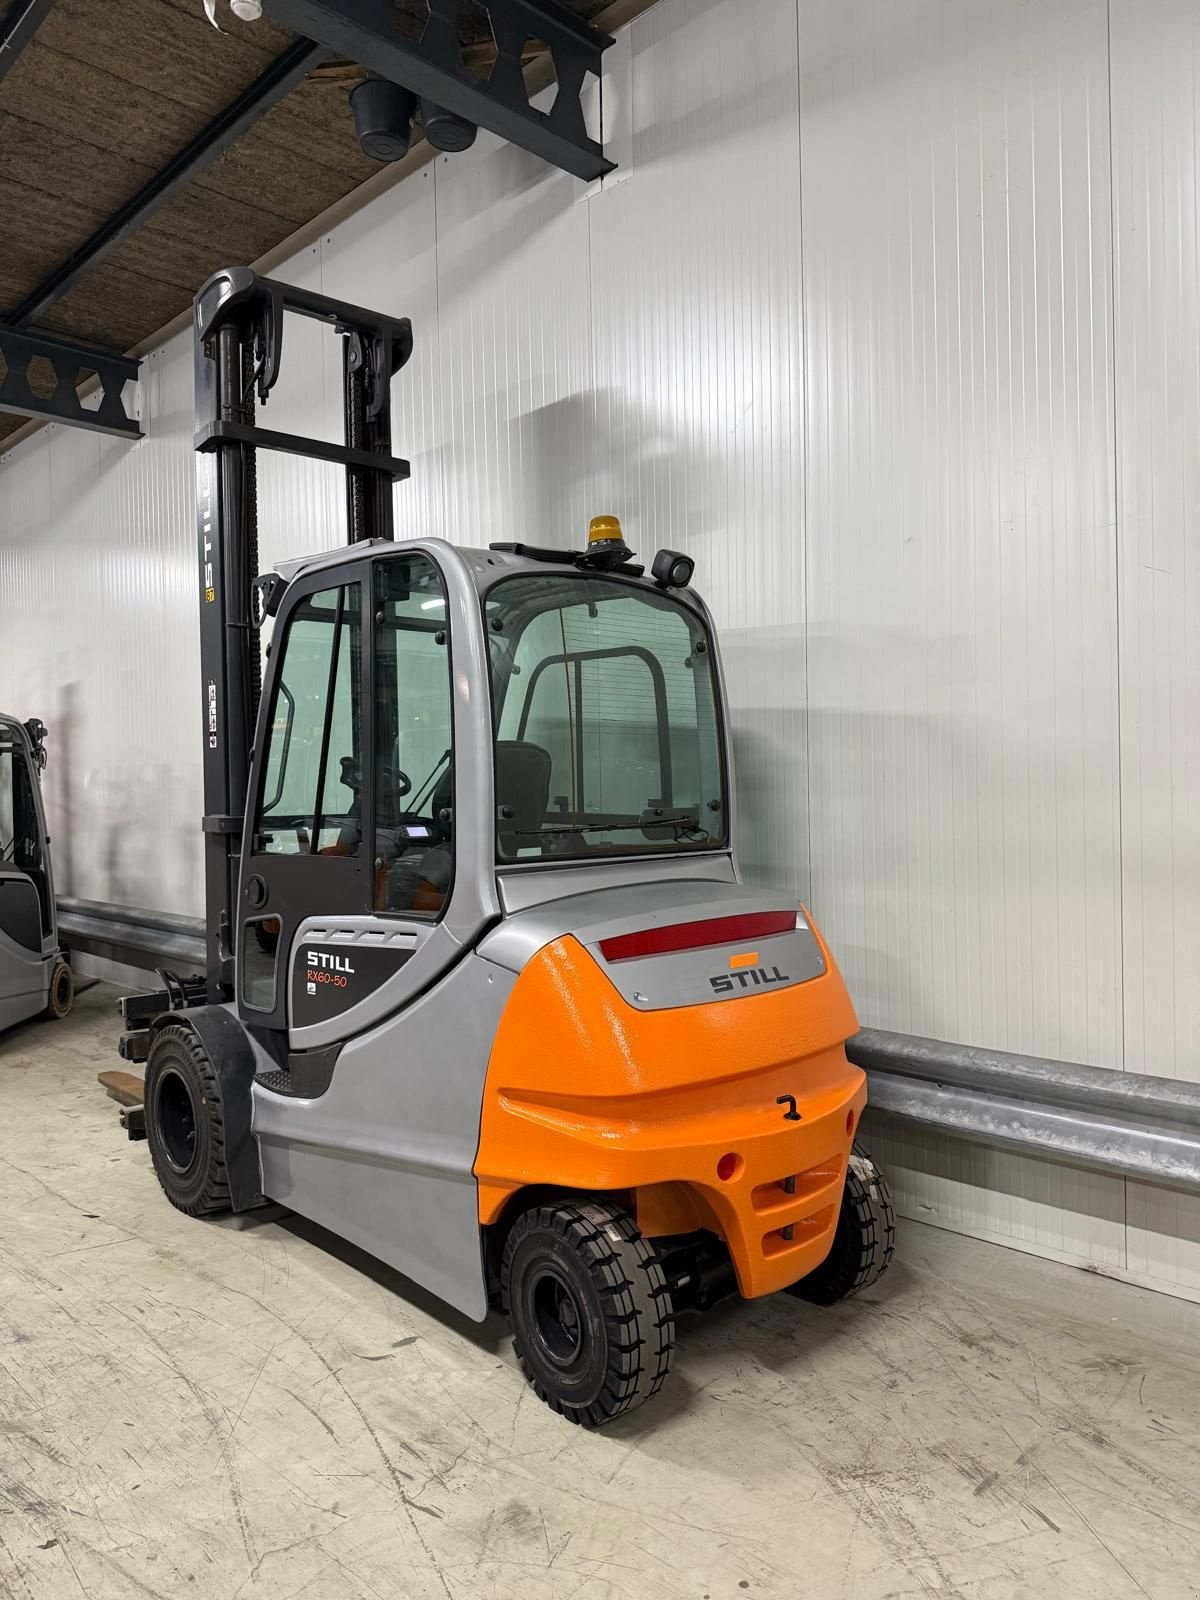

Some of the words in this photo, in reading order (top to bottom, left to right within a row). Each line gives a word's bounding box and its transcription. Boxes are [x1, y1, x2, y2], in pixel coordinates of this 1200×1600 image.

[307, 951, 355, 973] STILL
[307, 969, 348, 987] RX60-50
[709, 966, 790, 993] STILL
